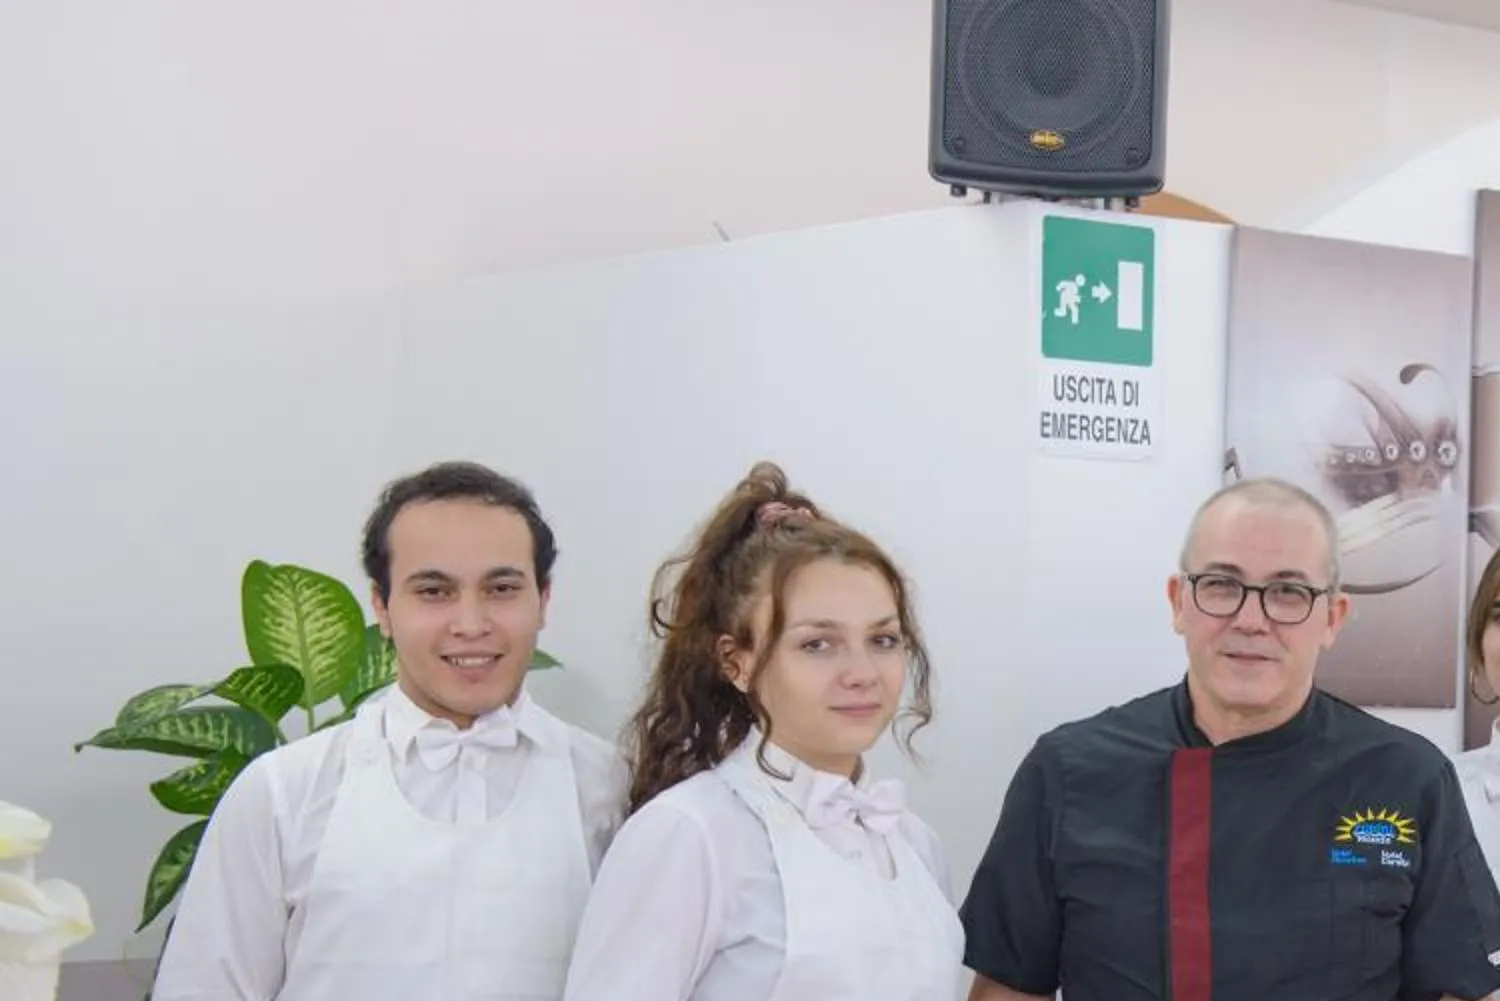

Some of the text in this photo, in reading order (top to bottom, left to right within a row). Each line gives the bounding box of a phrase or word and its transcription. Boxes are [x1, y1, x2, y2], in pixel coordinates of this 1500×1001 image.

[1053, 374, 1139, 407] USCITA DI
[1040, 411, 1151, 445] EMERGENZA
